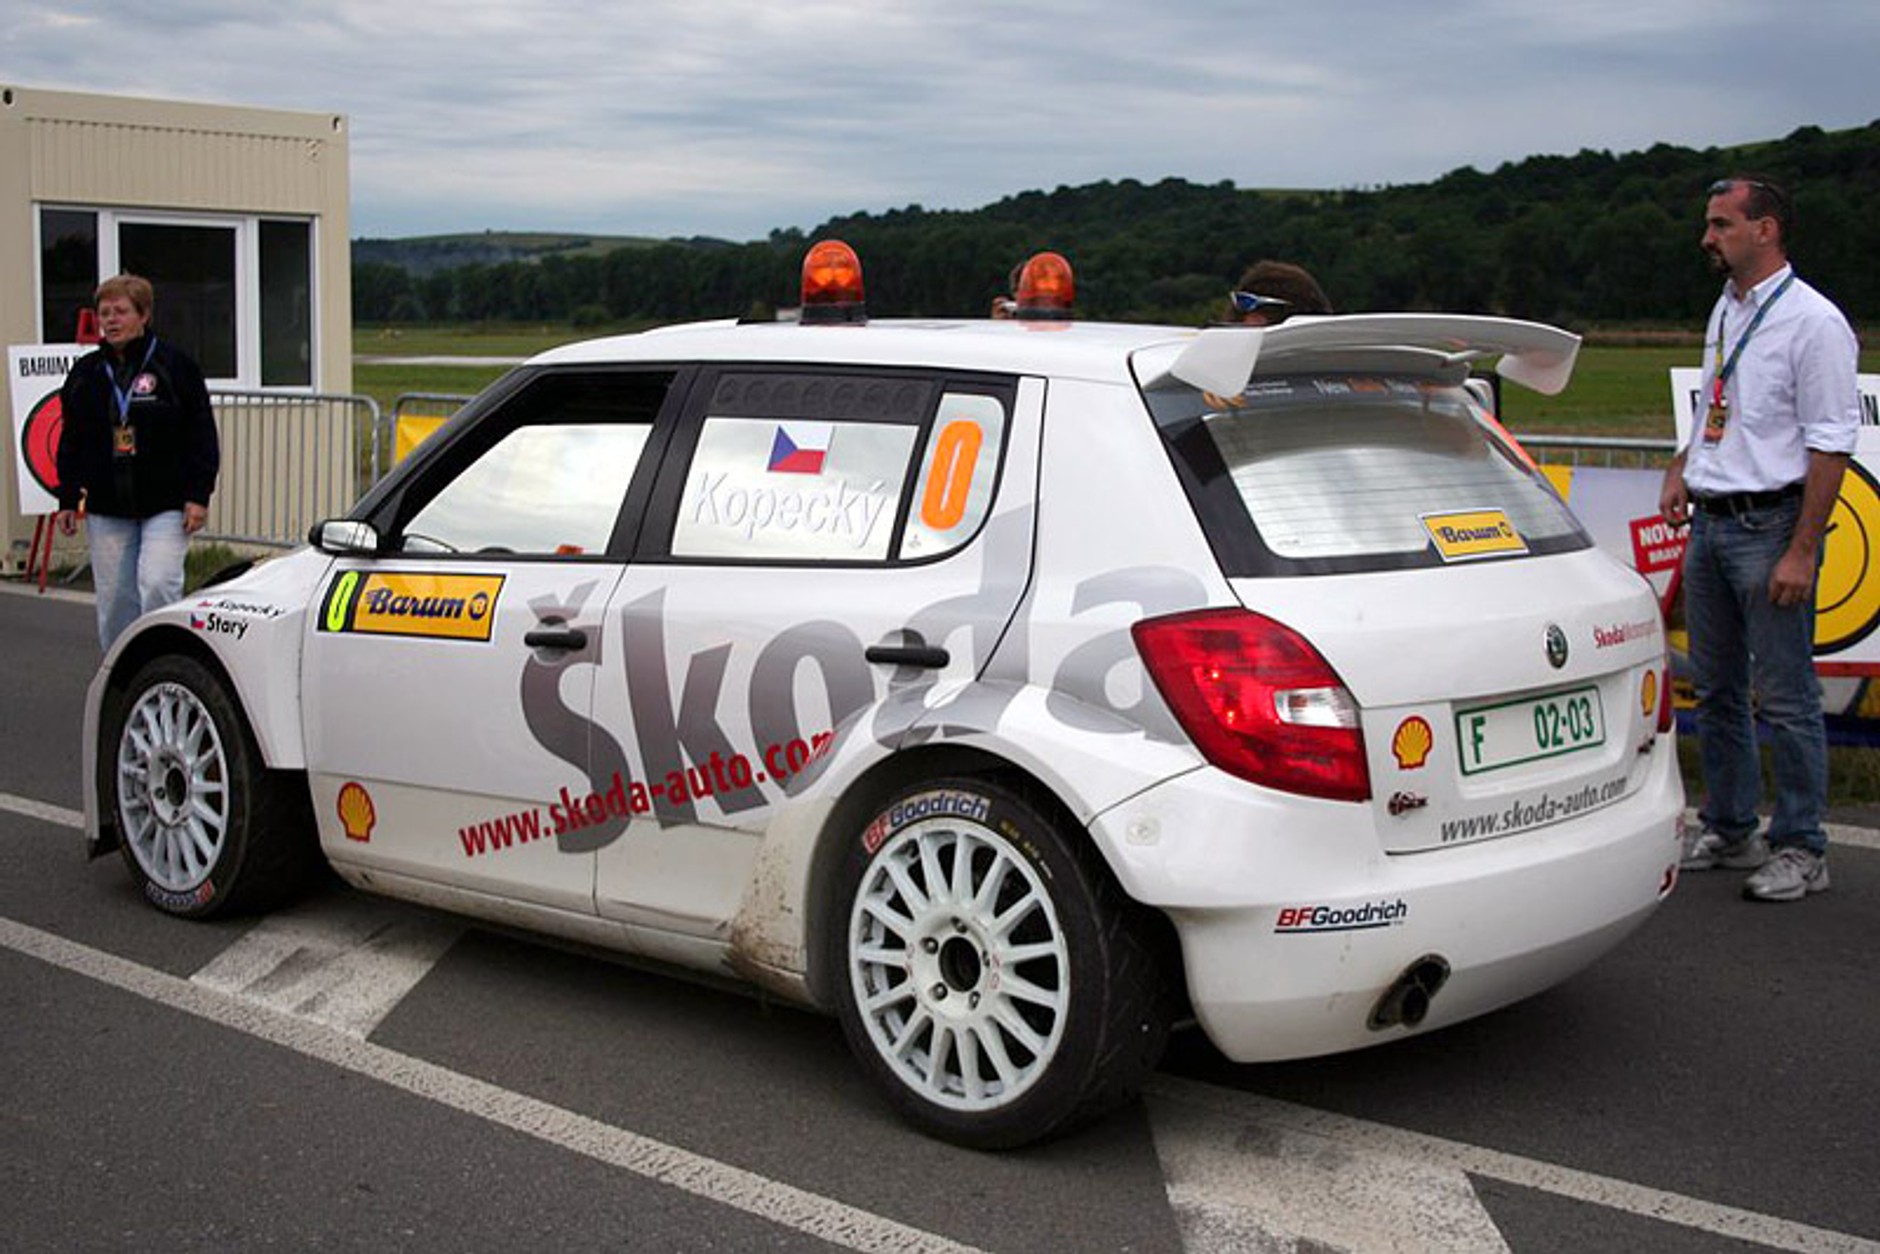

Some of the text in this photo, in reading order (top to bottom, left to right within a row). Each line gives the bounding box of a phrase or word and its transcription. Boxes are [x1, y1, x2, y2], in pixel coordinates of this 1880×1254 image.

[19, 354, 70, 377] BARUM
[921, 420, 983, 530] 0
[694, 471, 889, 549] Kopecký
[1437, 525, 1500, 543] Barum
[327, 571, 464, 632] 0 Barum
[1471, 716, 1485, 764] F
[459, 731, 836, 858] www.skoda-auto.com
[864, 793, 988, 851] BFGoodrich
[1441, 777, 1628, 842] www.skoda-auto.com
[1276, 899, 1407, 927] BFGoodrich
